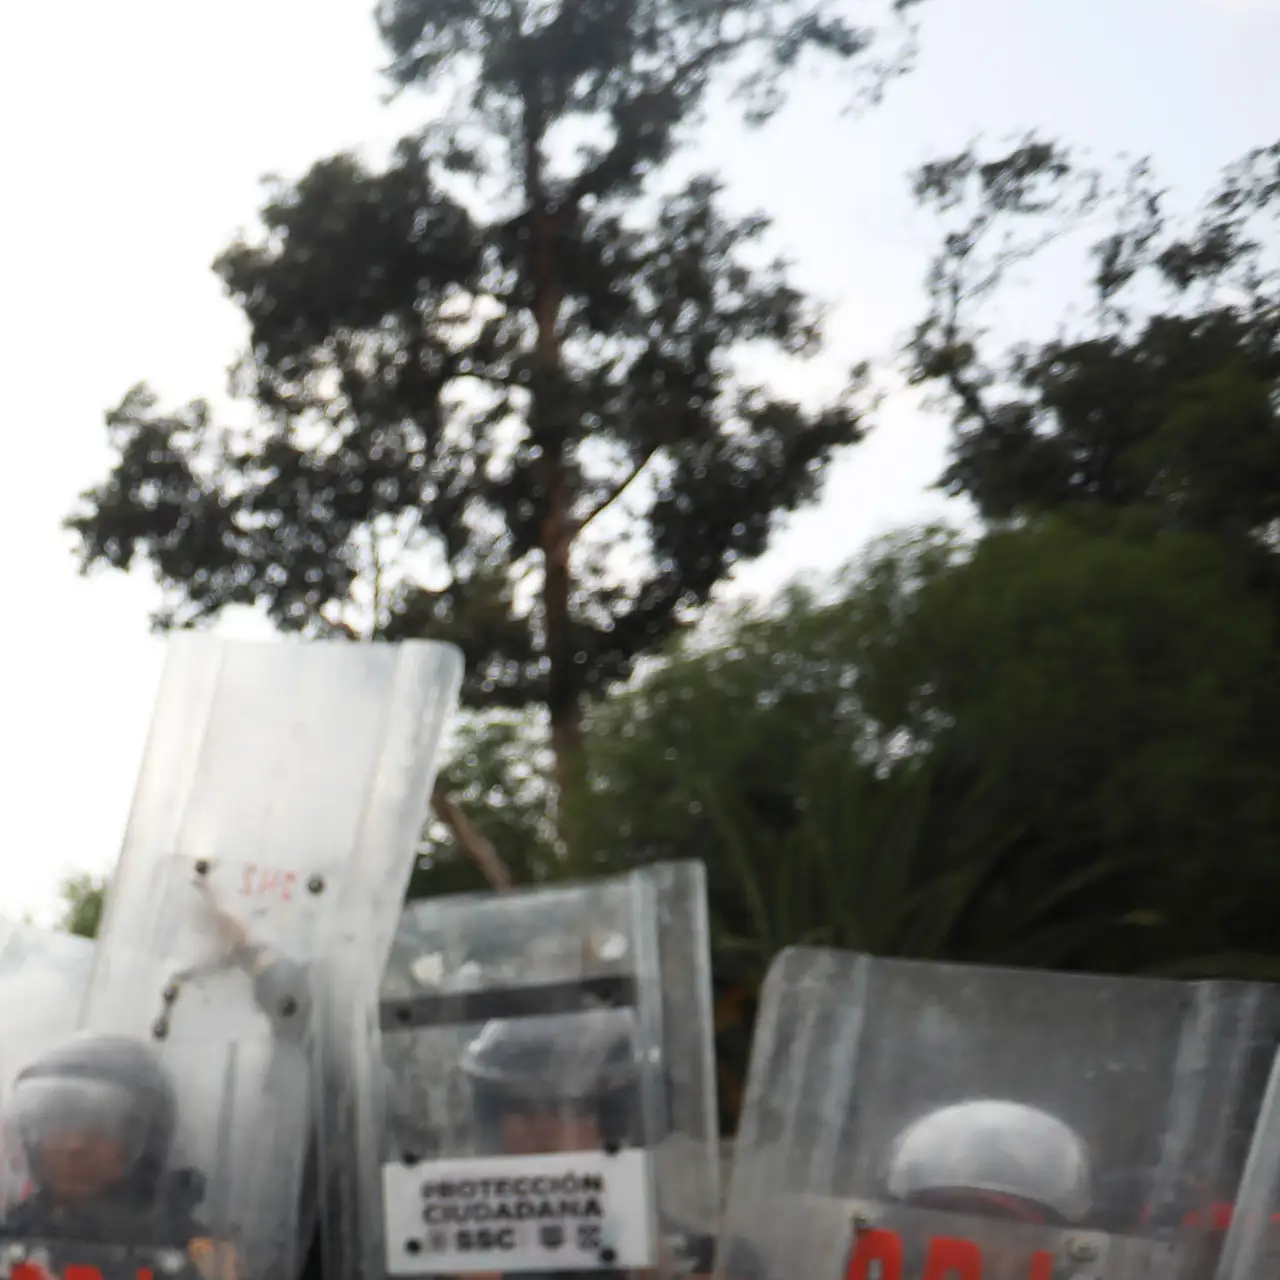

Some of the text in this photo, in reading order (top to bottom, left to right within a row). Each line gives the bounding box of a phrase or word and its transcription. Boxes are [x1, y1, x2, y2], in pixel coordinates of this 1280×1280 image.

[421, 1169, 604, 1199] PROTECCIÓN
[422, 1197, 604, 1226] CIUDADANA
[454, 1227, 514, 1251] SSC
